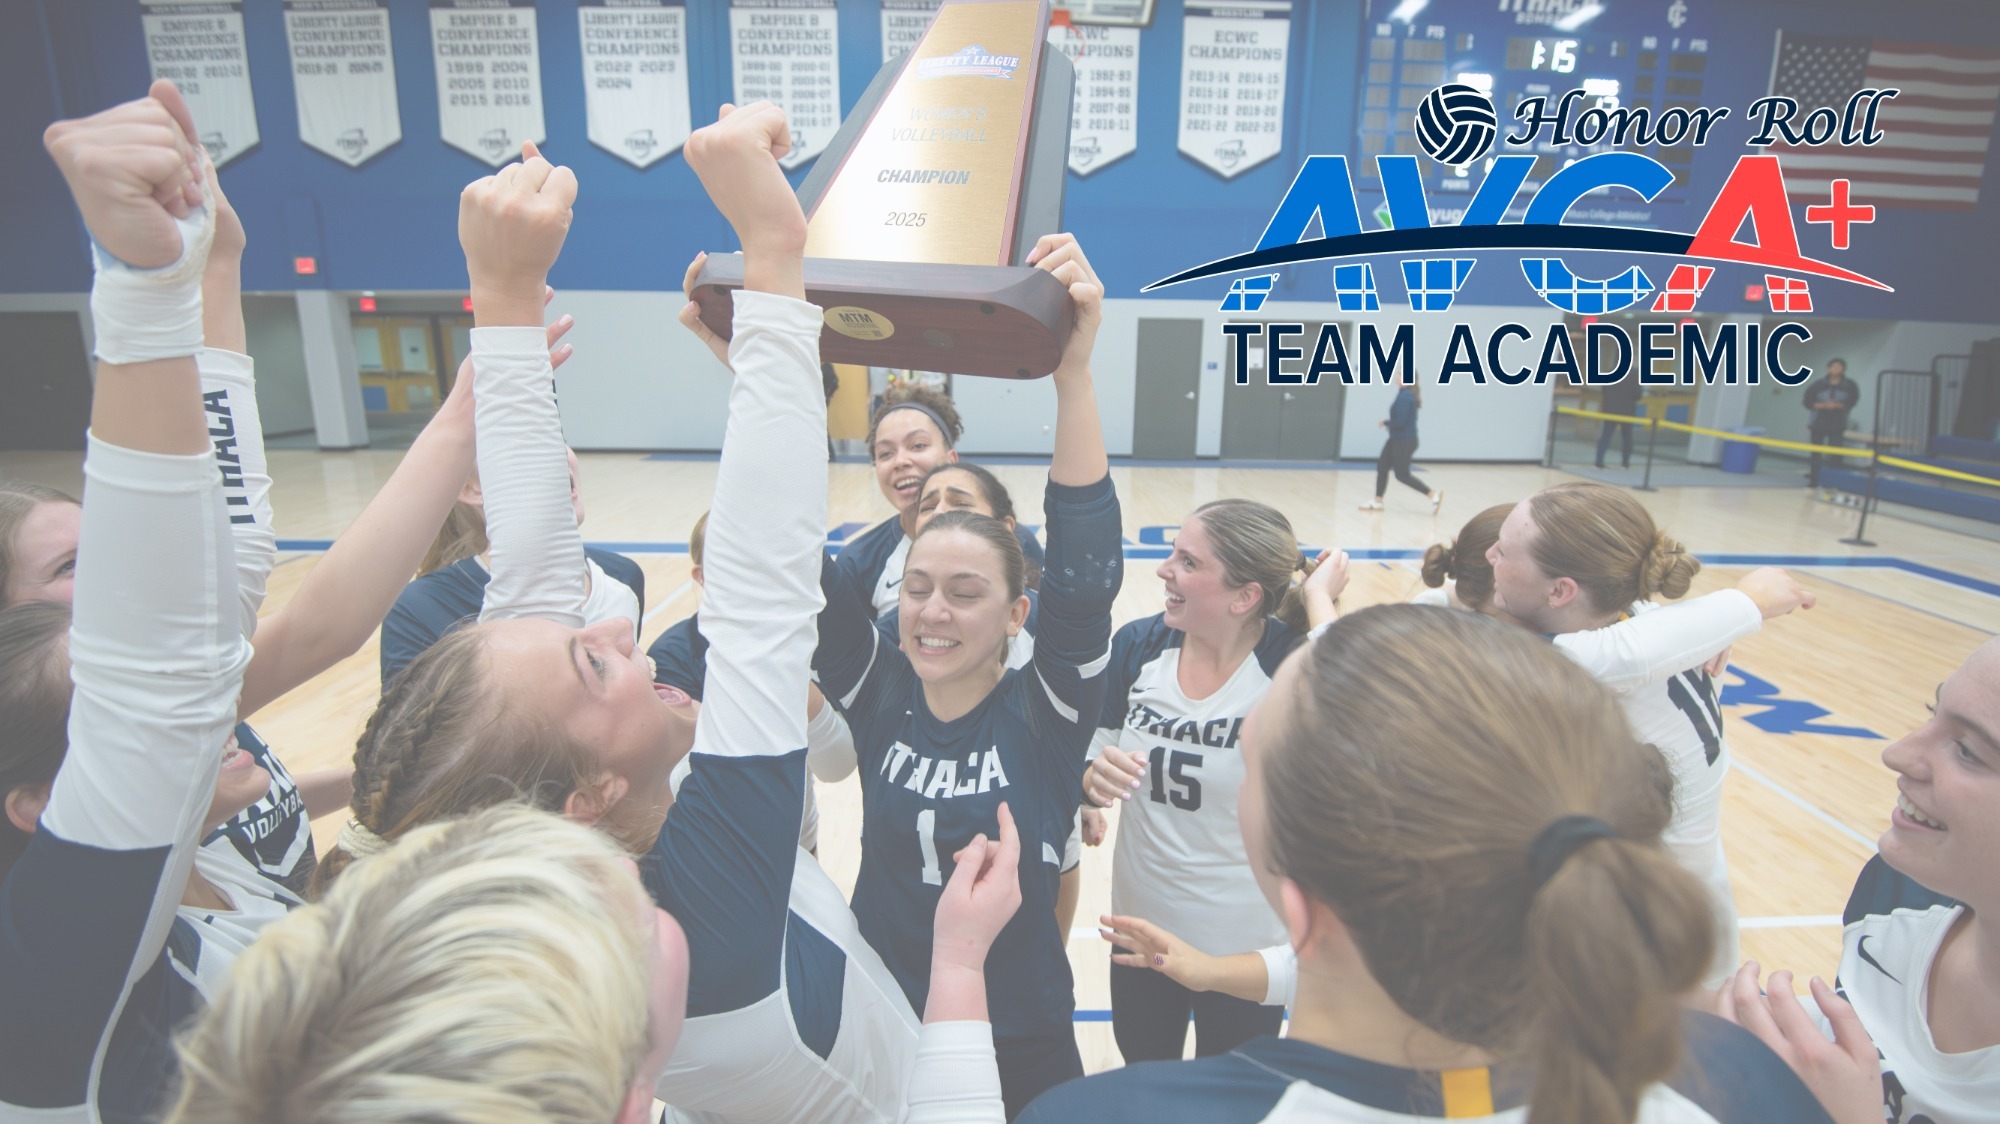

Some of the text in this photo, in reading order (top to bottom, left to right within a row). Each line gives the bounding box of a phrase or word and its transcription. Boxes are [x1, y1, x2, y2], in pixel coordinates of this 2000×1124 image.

[450, 13, 504, 26] EMPIRE
[585, 12, 679, 25] LIBERTY LEAGUE
[750, 14, 806, 26] EMPIRE
[150, 33, 240, 47] CONFERENCE
[292, 29, 384, 42] CONFERENCE
[437, 28, 530, 40] CONFERENCE
[585, 28, 679, 39] CONFERENCE
[738, 28, 831, 41] CONFERENCE
[1215, 30, 1259, 44] ECWC
[151, 47, 242, 61] CHAMPIONS
[293, 43, 386, 57] CHAMPIONS
[438, 43, 532, 56] CHAMPIONS
[587, 42, 681, 55] CHAMPIONS
[738, 43, 832, 56] CHAMPIONS
[1189, 45, 1282, 61] CHAMPIONS
[972, 55, 1020, 68] LEAGUE
[891, 127, 988, 143] VOLLEYBALL
[877, 168, 971, 185] CHAMPION
[884, 211, 928, 228] 2025
[838, 312, 873, 323] MTM
[880, 741, 1011, 799] ITHACA
[1148, 746, 1204, 812] 15
[917, 808, 943, 886] 1
